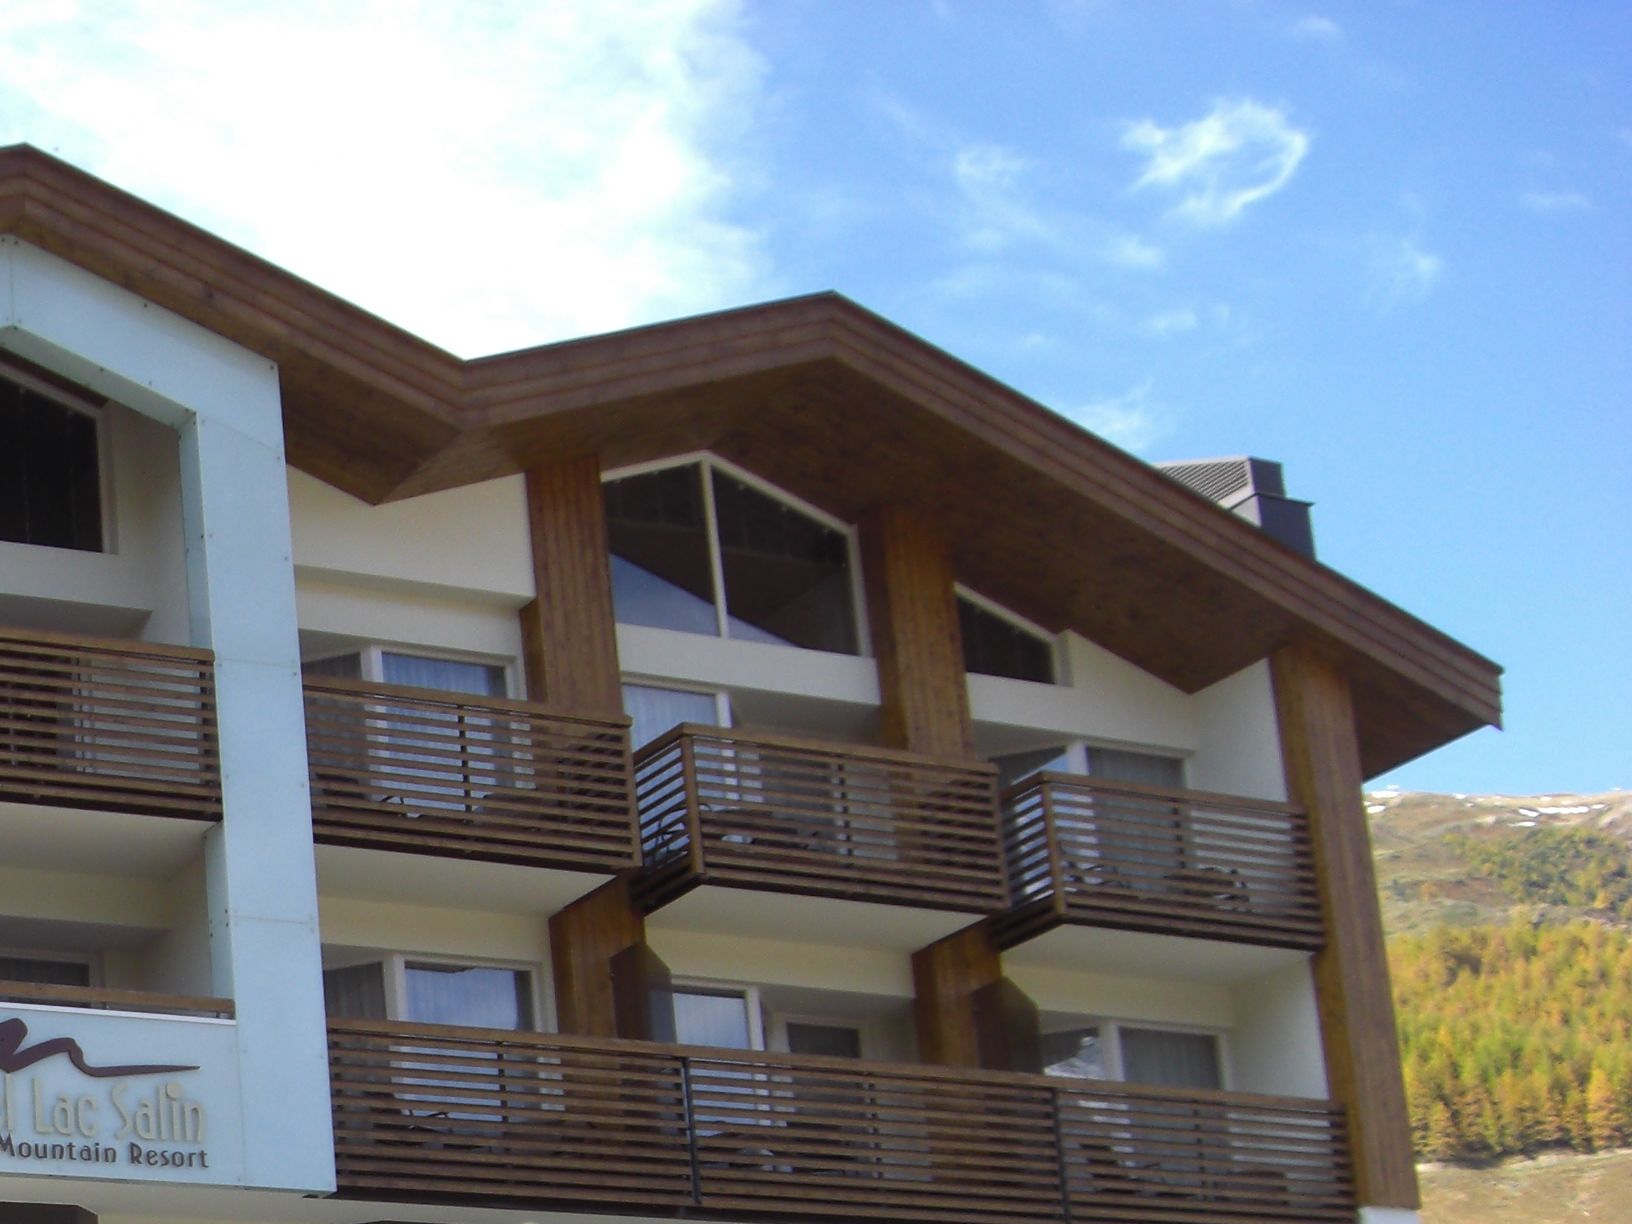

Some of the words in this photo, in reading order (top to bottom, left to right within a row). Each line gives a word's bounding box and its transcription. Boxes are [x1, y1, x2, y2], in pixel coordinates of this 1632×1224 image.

[32, 1077, 97, 1138] Lac
[111, 1080, 205, 1143] Salin
[129, 1141, 210, 1169] Resort
